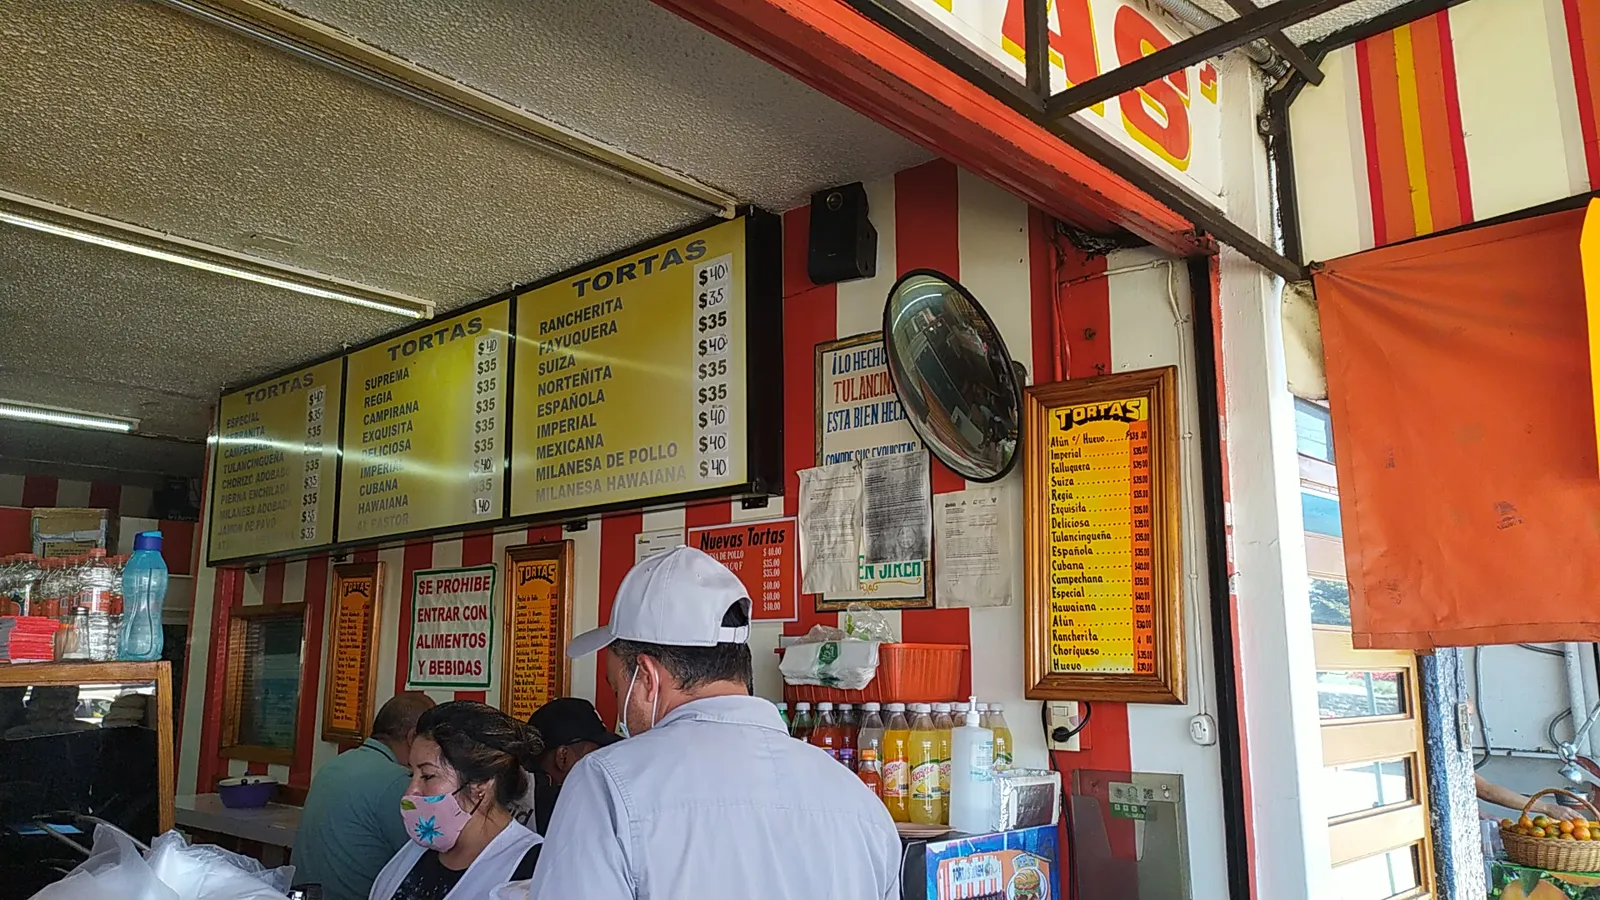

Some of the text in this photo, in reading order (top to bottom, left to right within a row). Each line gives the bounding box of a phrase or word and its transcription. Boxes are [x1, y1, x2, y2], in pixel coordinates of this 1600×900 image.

[572, 240, 707, 298] TORTAS
[698, 288, 724, 310] $35
[540, 296, 623, 335] RANCHERITA
[698, 311, 727, 333] $35
[387, 317, 482, 361] TORTAS
[539, 319, 618, 355] FAYUQUERA
[698, 336, 725, 357] $40
[478, 339, 497, 356] $40
[477, 358, 497, 376] $35
[538, 354, 576, 377] SUIZA
[698, 359, 727, 381] $35
[245, 373, 314, 404] TORTAS
[365, 367, 410, 392] SUPREMA
[477, 378, 496, 395] $35
[538, 365, 612, 397] NORTEÑITA
[833, 371, 896, 405] TULANCIN
[364, 390, 392, 409] REGIA
[537, 389, 605, 418] ESPAÑOLA
[698, 383, 727, 405] $35
[363, 400, 419, 426] CAMPIRANA
[476, 398, 496, 415] $35
[1055, 399, 1141, 431] TORTAS
[227, 412, 260, 429] ESPECIAL
[475, 417, 495, 434] $35
[537, 413, 597, 439] IMPERIAL
[698, 408, 725, 428] $40
[826, 408, 851, 434] ESTA
[854, 403, 879, 428] BIEN
[307, 425, 321, 438] $35
[362, 420, 413, 444] EXQUISITA
[1083, 433, 1105, 444] Huevo
[361, 439, 411, 459] DELICIOSA
[474, 437, 494, 454] $35
[536, 433, 604, 460] MEXICANA
[698, 434, 725, 453] $40
[536, 442, 678, 481] MILANESA DE POLLO
[1051, 448, 1081, 461] Imperial
[305, 459, 319, 473] $35
[360, 459, 404, 479] IMPERIAL
[699, 459, 726, 478] $40
[1051, 462, 1090, 474] Falluquera
[222, 475, 253, 489] CHORIZO
[359, 478, 398, 497] CUBANA
[535, 465, 687, 503] MILANESA HAWAIANA
[1051, 476, 1074, 487] Suiza
[220, 491, 247, 505] PIERNA
[302, 493, 317, 506] $35
[358, 494, 408, 515] HAWAIANA
[1051, 489, 1073, 503] Regia
[1051, 502, 1086, 516] Exquisita
[1051, 517, 1090, 529] Deliciosa
[300, 528, 314, 540] $35
[700, 532, 743, 550] Nuevas
[747, 527, 786, 546] Tortas
[1051, 531, 1112, 544] Tulancingueña
[727, 549, 744, 560] POLLO
[1052, 545, 1093, 559] Española
[518, 564, 556, 586] TORTAS
[1052, 560, 1084, 571] Cubana
[419, 576, 491, 595] SE PROHIBE
[1052, 571, 1103, 585] Campechana
[1052, 586, 1085, 599] Especial
[418, 605, 487, 623] ENTRAR CON
[1052, 601, 1097, 612] Hawaiana
[416, 632, 486, 649] ALIMENTOS
[1052, 628, 1098, 641] Rancherita
[1053, 644, 1099, 658] Choriqueso
[418, 660, 482, 675] Y BEBIDAS
[1053, 658, 1081, 671] Huevo
